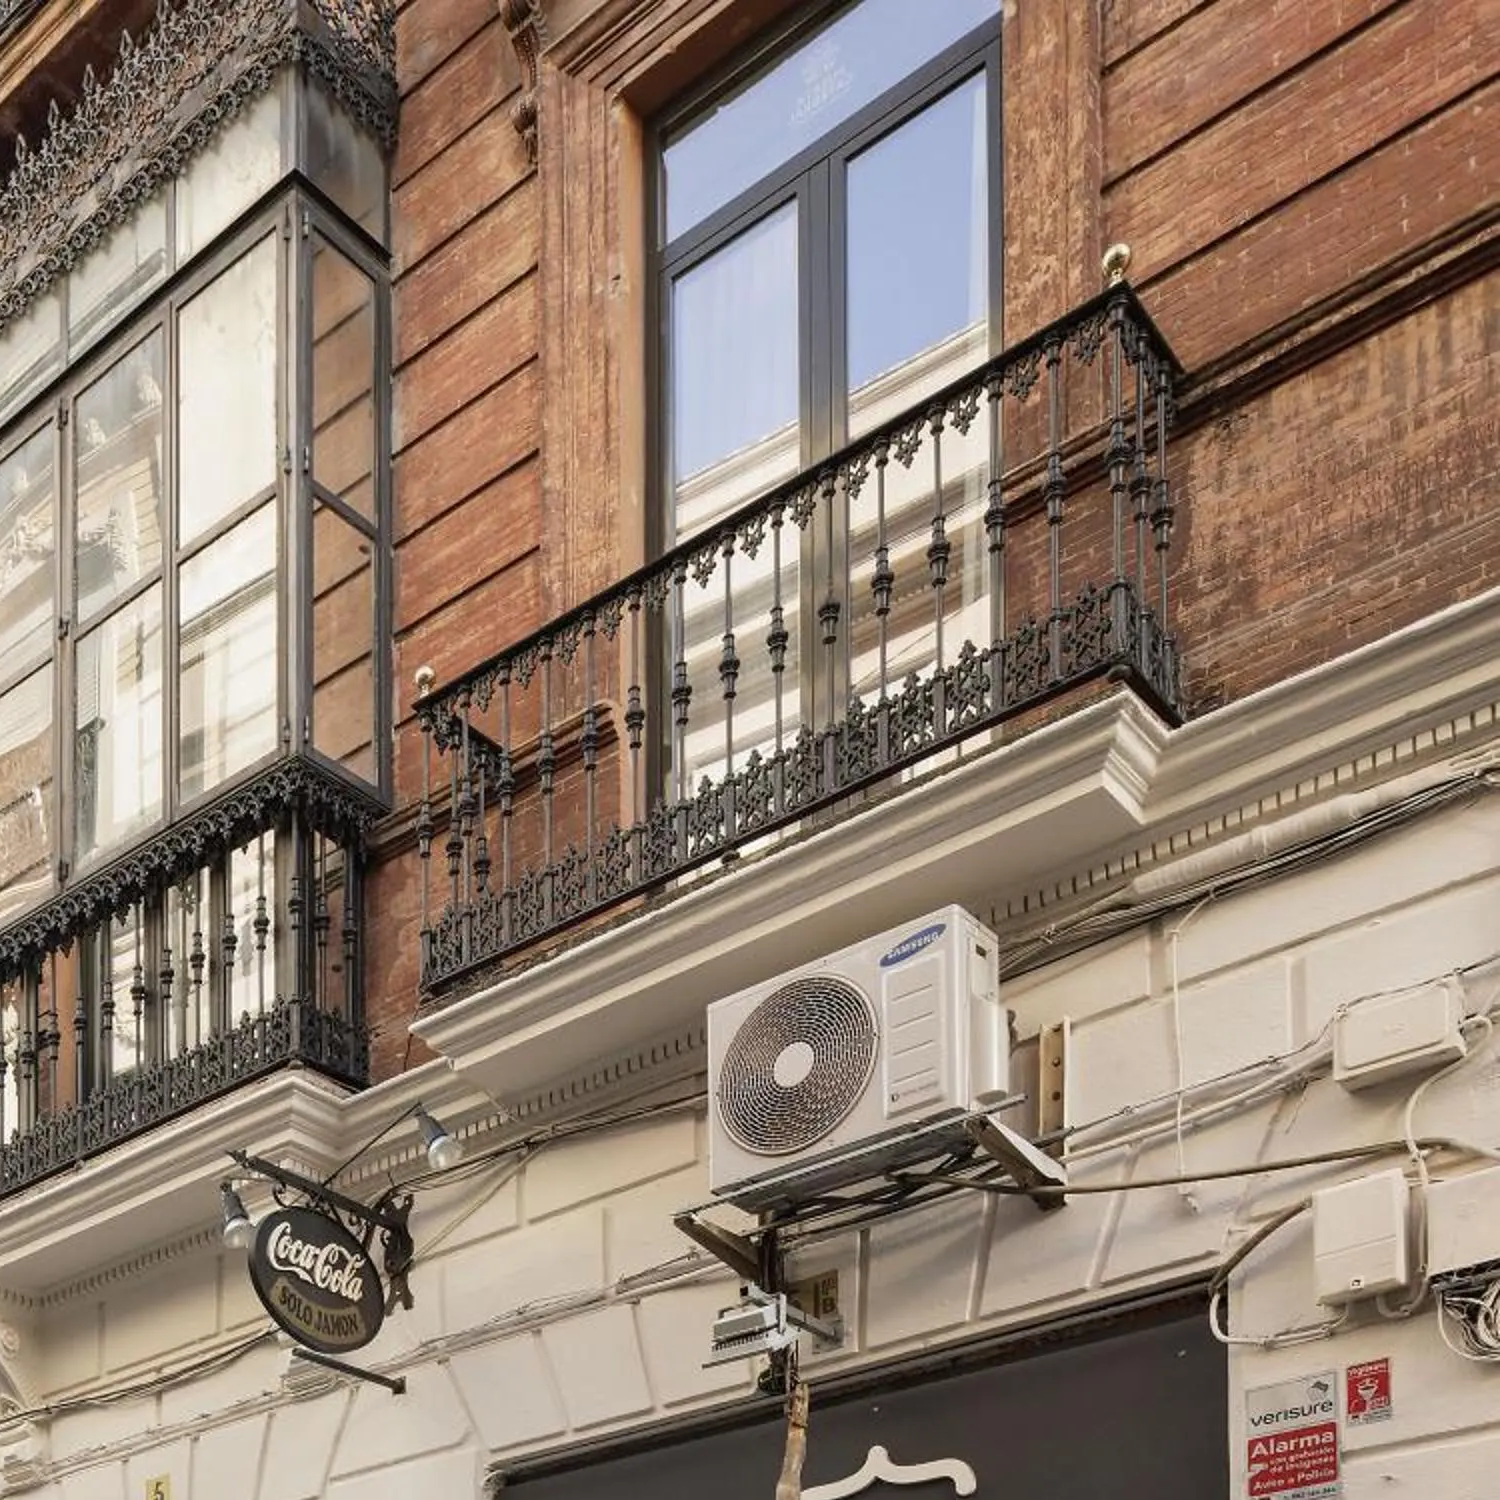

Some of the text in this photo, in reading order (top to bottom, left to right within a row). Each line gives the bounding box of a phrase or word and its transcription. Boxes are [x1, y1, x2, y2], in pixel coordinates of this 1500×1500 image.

[887, 931, 939, 959] SAMSUNG
[279, 1285, 313, 1326] SOLO
[1250, 1400, 1333, 1427] verisure
[1250, 1431, 1335, 1459] Alarma
